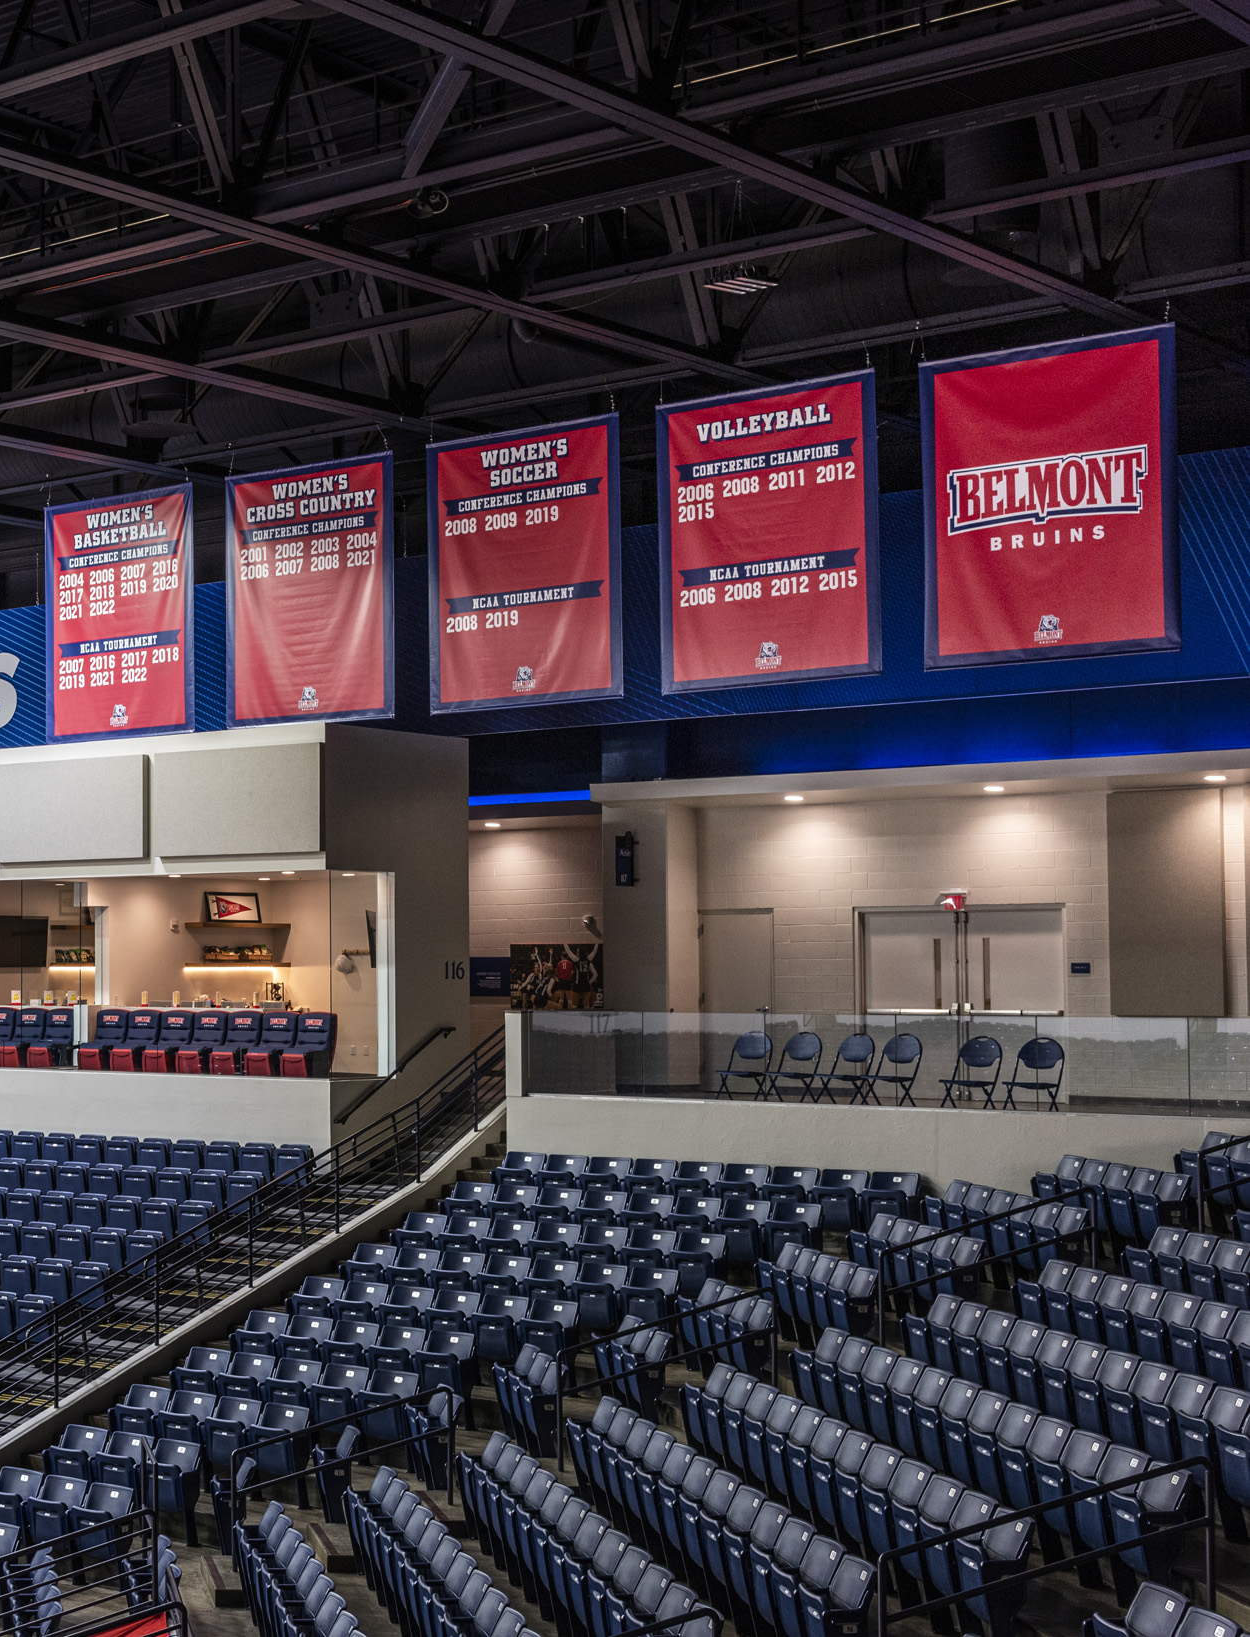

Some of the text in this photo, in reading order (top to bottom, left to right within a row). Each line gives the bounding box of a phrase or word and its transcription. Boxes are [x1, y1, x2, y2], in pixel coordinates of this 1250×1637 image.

[696, 403, 831, 443] VOLLEYBALL
[481, 438, 568, 469] WOMEN'S
[692, 444, 839, 478] CONFERENCE CHAMPIONS
[272, 474, 349, 500] WOMEN'S
[490, 461, 558, 488] SOCCER
[677, 462, 856, 503] 2006 2008 2011 2012
[458, 483, 587, 513] CONFERENCE CHAMPIONS
[948, 446, 1147, 535] BELMONT
[86, 504, 153, 529] WOMEN'S
[247, 489, 376, 524] CROSS COUNTRY
[678, 502, 714, 523] 2015
[252, 516, 365, 541] CONFERENCE CHAMPIONS
[445, 505, 559, 537] 2008 2009 2019
[74, 521, 167, 550] BASKETBALL
[241, 532, 377, 564] 2001 2002 2003 2004
[990, 525, 1105, 552] BRUINS
[69, 544, 168, 568] CONFERENCE CHAMPIONS
[241, 549, 375, 581] 2006 2007 2008 2021
[709, 556, 825, 581] NCAA TOURNAMENT
[59, 559, 178, 589] 2004 2006 2007 2016
[60, 574, 178, 605] 2017 2018 2019 2020
[472, 587, 574, 609] NCAA TOURNAMENT
[680, 570, 858, 607] 2006 2008 2012 2015
[60, 600, 115, 621] 2021 2022
[446, 610, 519, 633] 2008 2019
[80, 635, 157, 654] NCAA TOURNAMENT
[59, 647, 179, 675] 2007 2016 2017 2018
[59, 667, 147, 690] 2019 2021 2022
[445, 960, 465, 979] 116
[590, 1013, 610, 1033] 117
